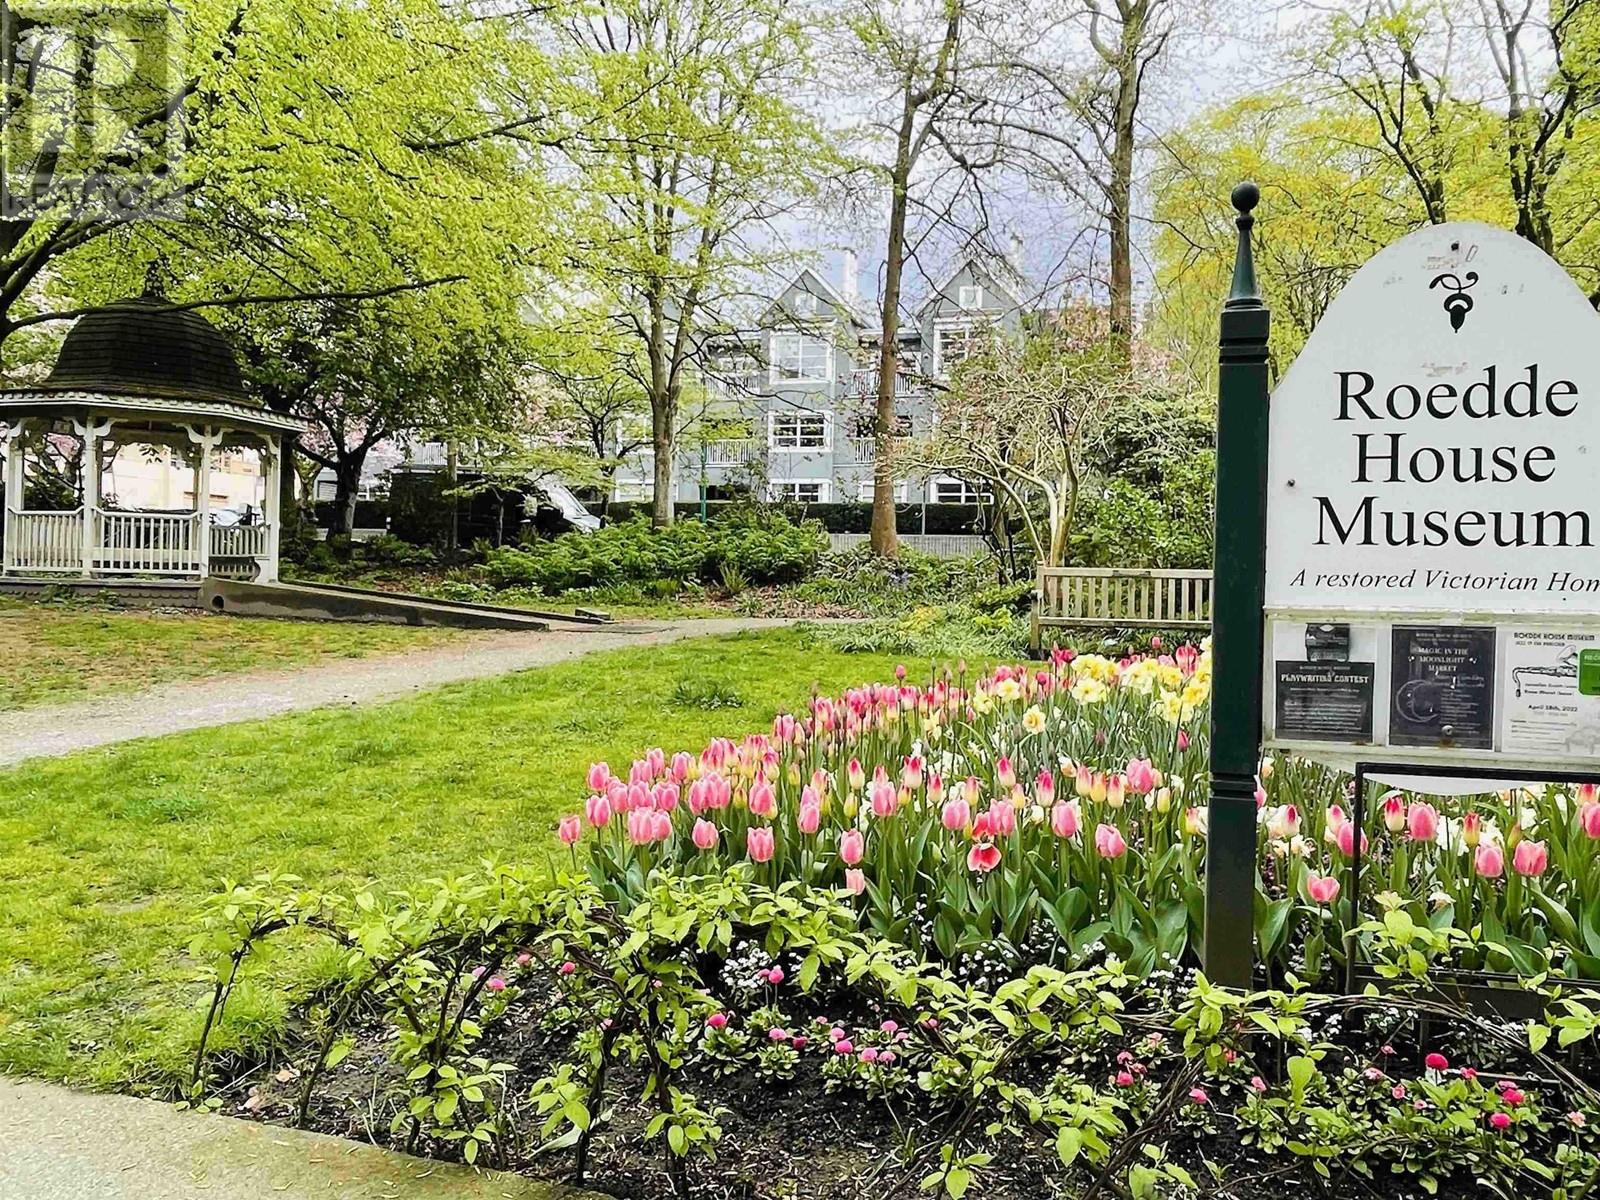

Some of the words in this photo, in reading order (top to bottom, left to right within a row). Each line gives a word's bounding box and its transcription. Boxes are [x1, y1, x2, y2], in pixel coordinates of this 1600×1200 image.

[1334, 364, 1578, 420] Roedde
[1352, 433, 1555, 482] House
[1313, 497, 1594, 547] Museum
[1290, 569, 1305, 586] A
[1316, 569, 1416, 587] restored
[1426, 570, 1537, 590] Victorian
[1419, 656, 1465, 664] MOONLIGHT
